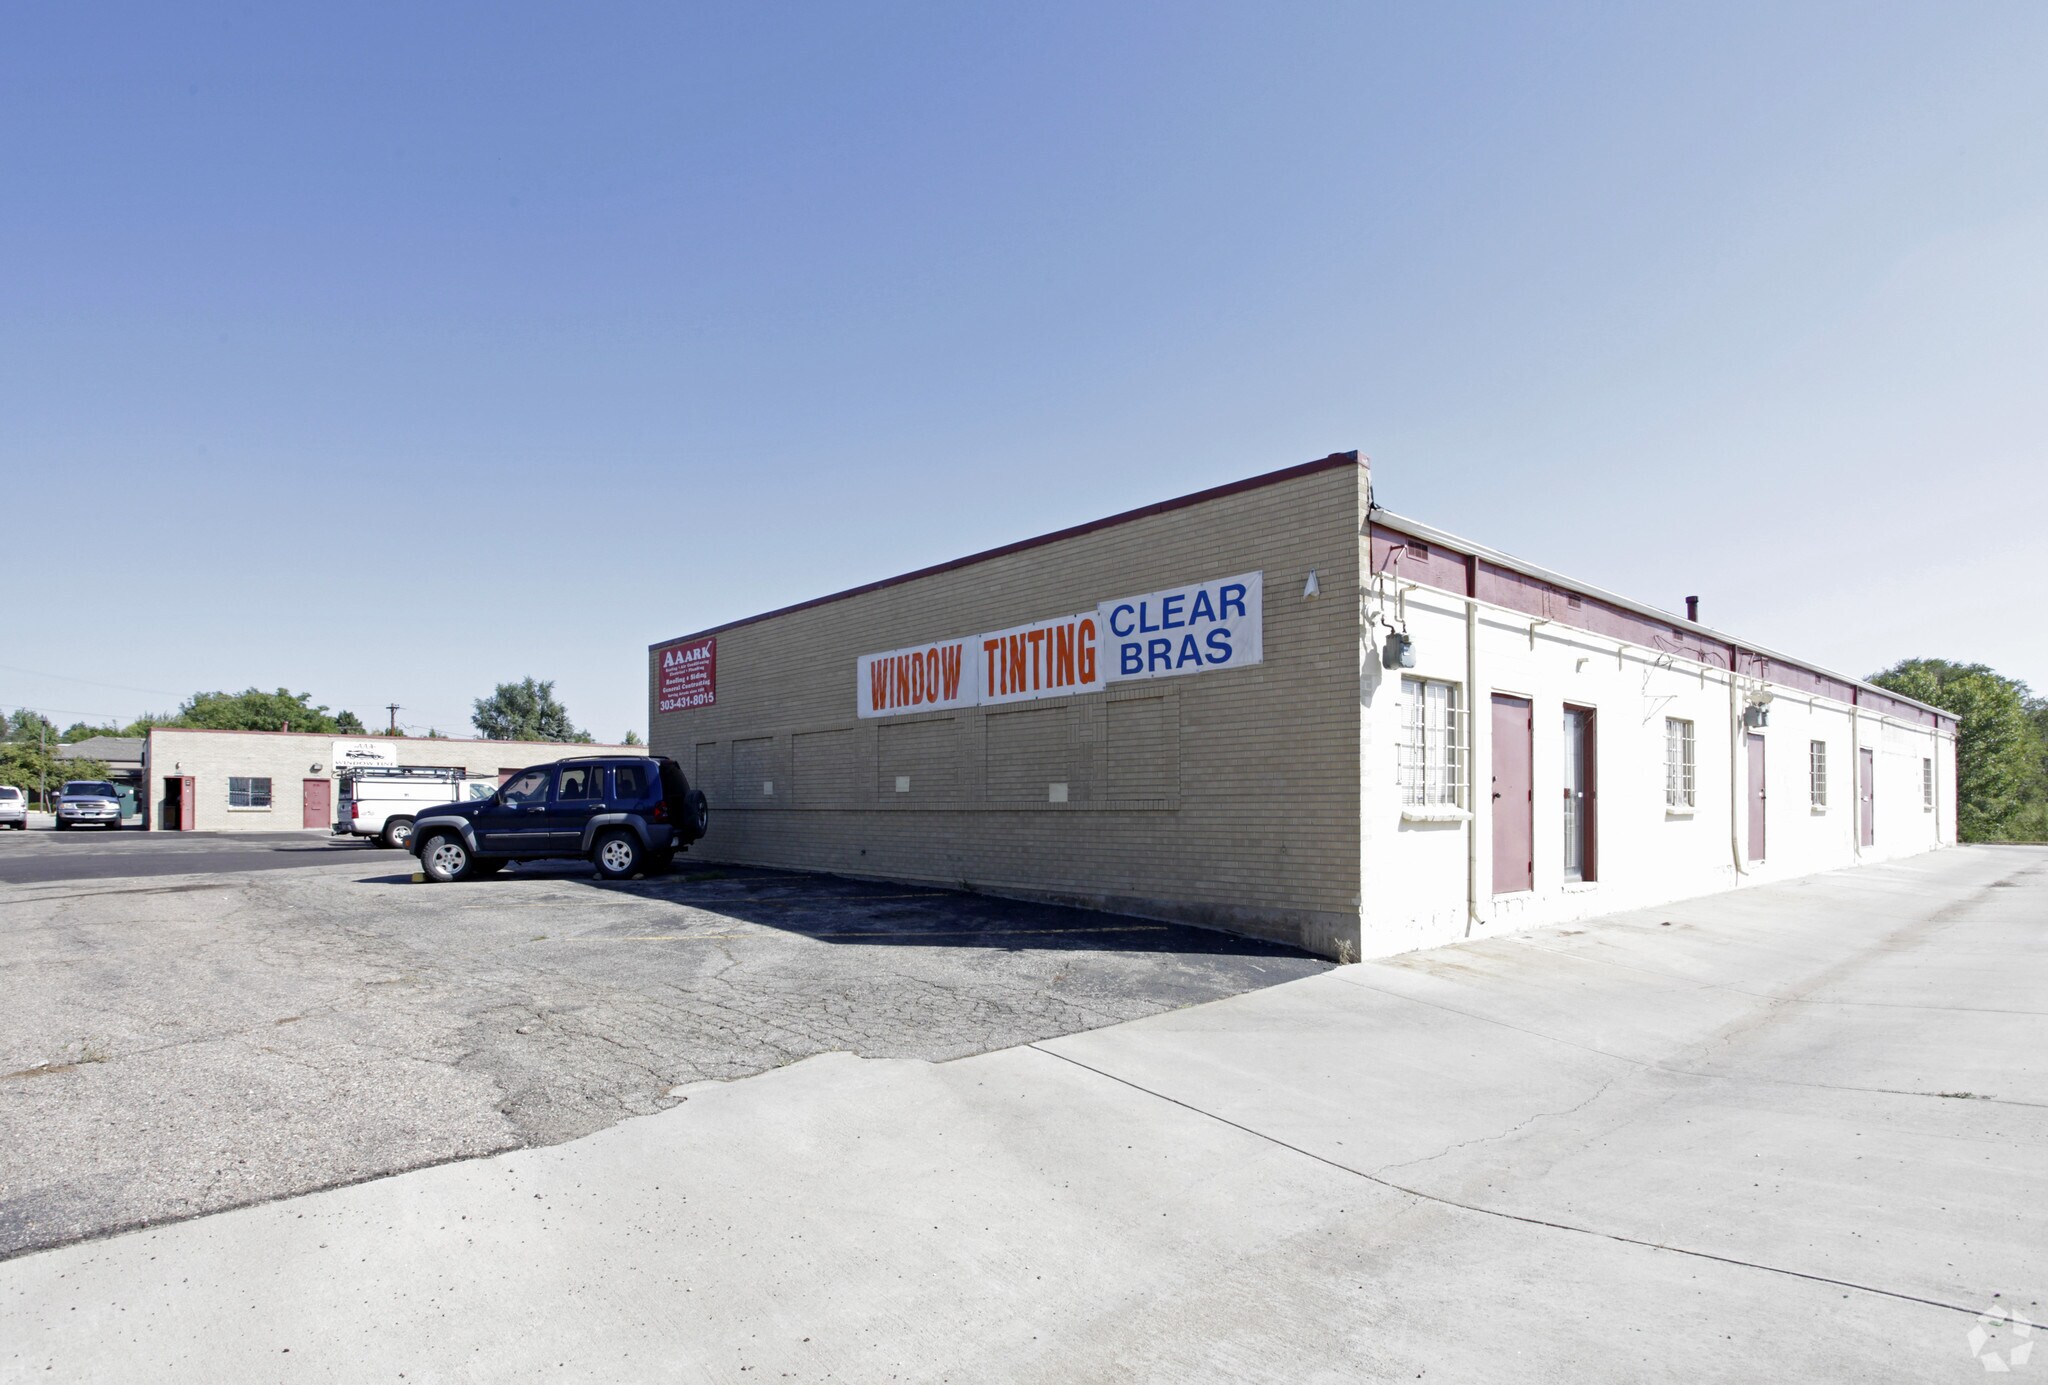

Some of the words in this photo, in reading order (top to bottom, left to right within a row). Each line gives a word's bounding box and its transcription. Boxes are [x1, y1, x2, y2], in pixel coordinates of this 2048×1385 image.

[1110, 584, 1246, 637] CLEAR
[663, 641, 712, 668] AAARK
[870, 644, 962, 710] WINDOW
[984, 619, 1095, 697] TINTING
[1121, 628, 1232, 675] BRAS
[663, 686, 681, 694] General
[690, 672, 707, 681] Siding
[660, 691, 714, 711] 303-431-8015
